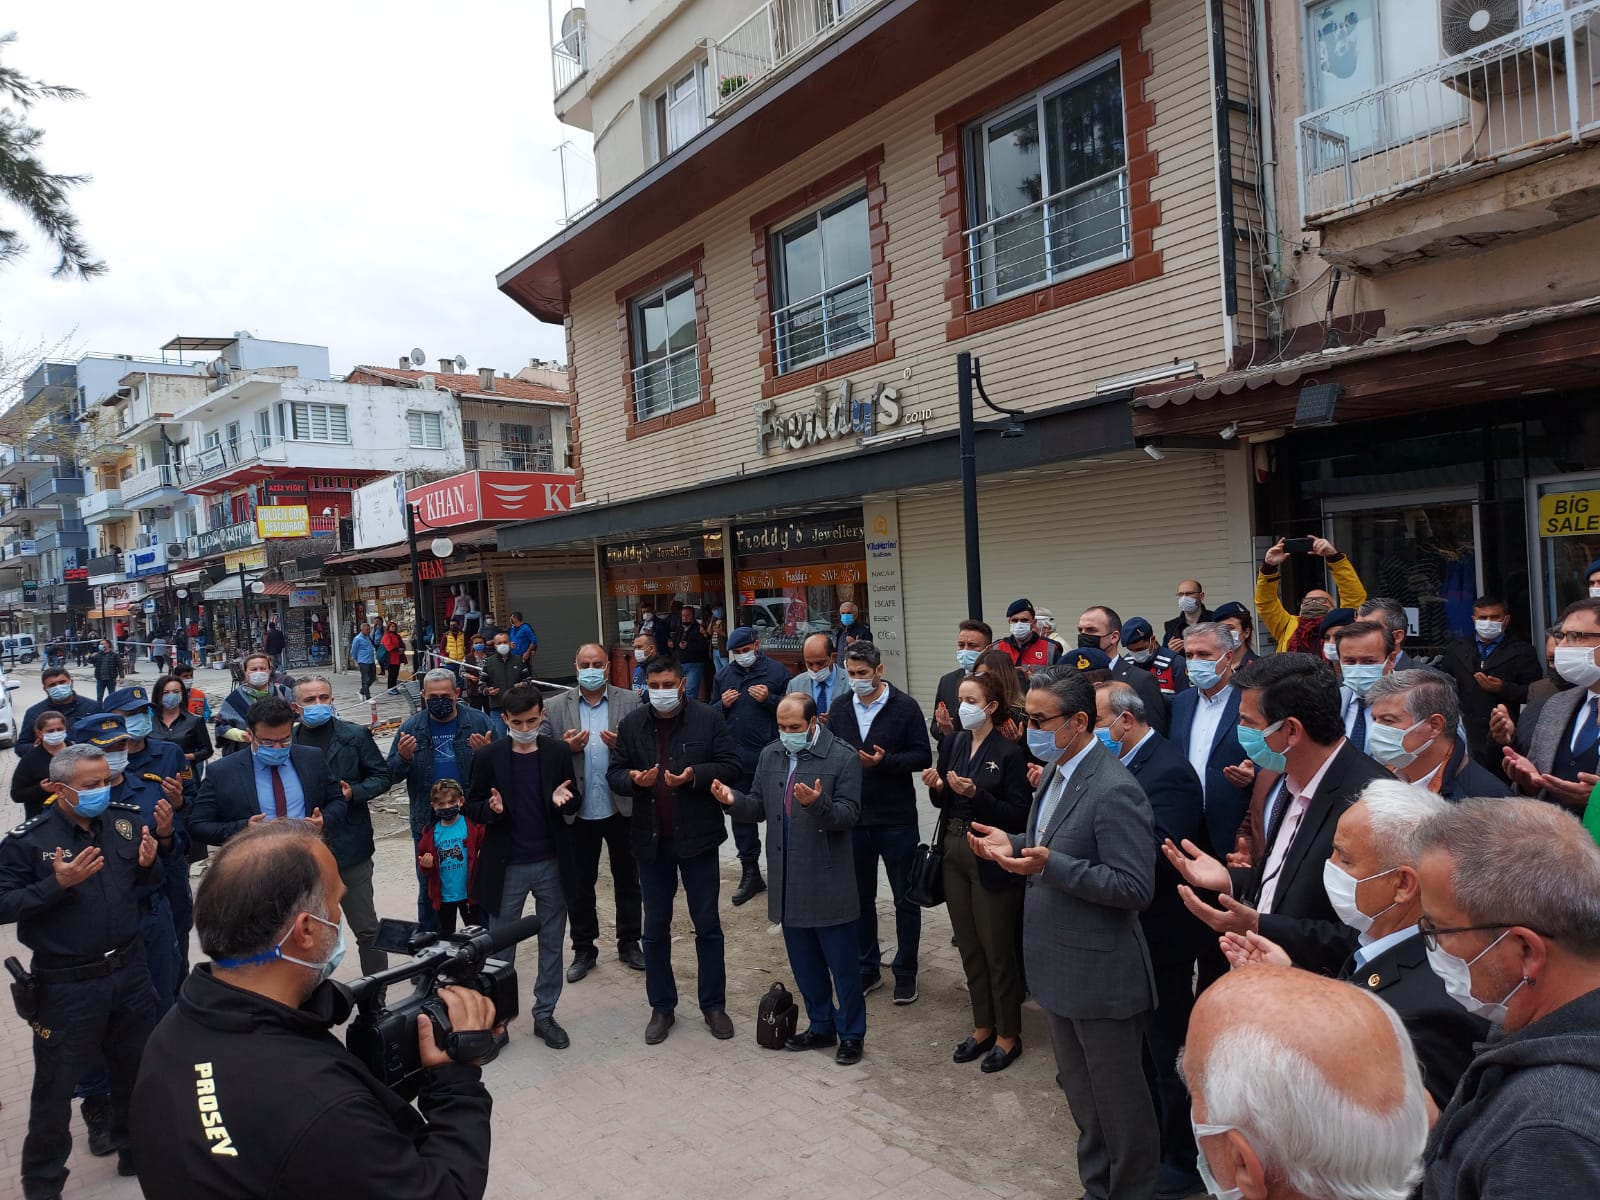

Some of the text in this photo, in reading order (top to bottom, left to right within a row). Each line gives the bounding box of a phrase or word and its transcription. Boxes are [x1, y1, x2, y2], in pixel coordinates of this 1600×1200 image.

[753, 379, 902, 456] Freddy's
[424, 484, 465, 521] KHAN
[259, 507, 288, 521] GOLDEN
[1546, 514, 1600, 533] SALE
[264, 520, 306, 533] RESTAURANT
[811, 524, 865, 542] Jewellery
[194, 1061, 238, 1157] PROSEV
